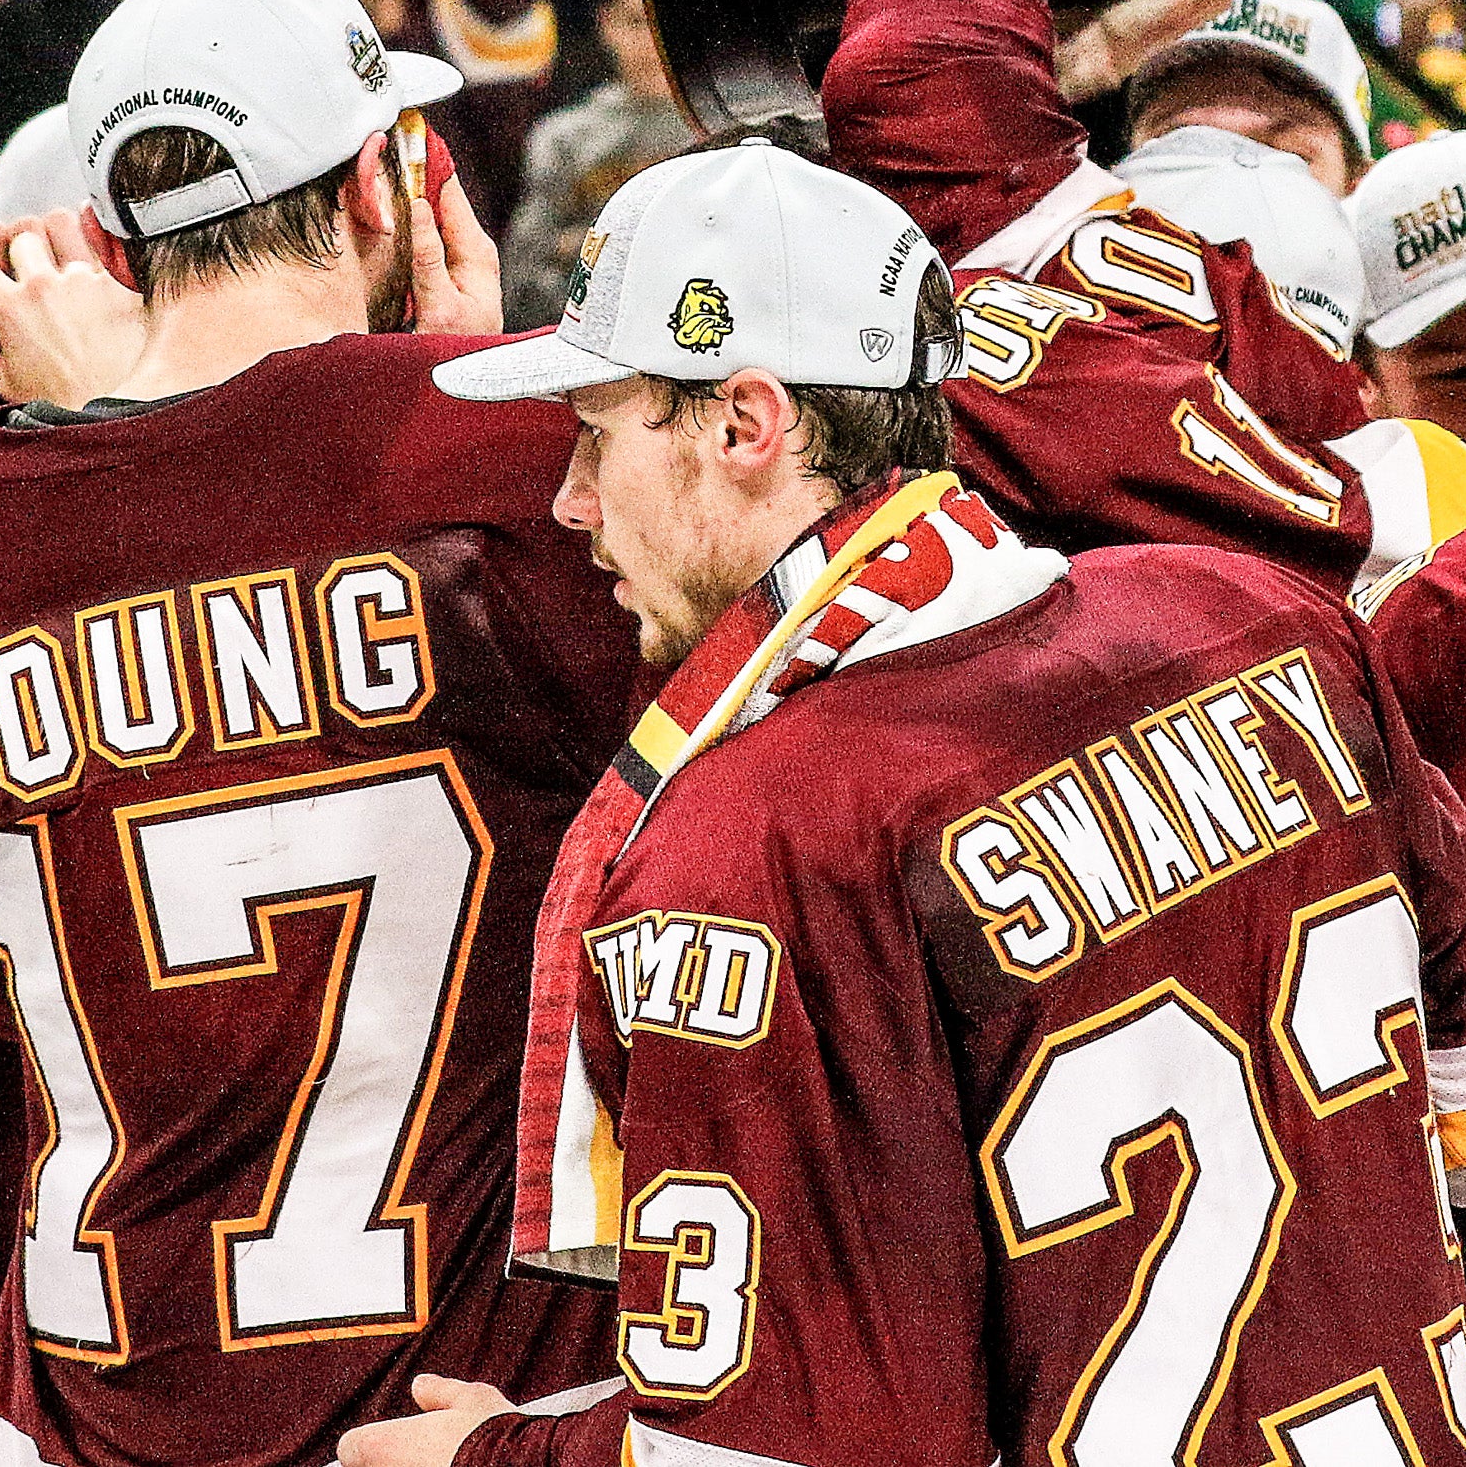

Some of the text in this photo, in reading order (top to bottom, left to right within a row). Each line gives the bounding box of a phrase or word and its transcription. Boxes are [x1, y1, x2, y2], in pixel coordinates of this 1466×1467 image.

[87, 87, 249, 170] NCAA NATIONAL CHAMPIONS
[879, 255, 905, 297] NCAA
[1294, 285, 1350, 328] CHAMPIONS
[941, 647, 1371, 983] SWANEY
[582, 910, 782, 1050] UMD
[618, 1169, 763, 1401] 3
